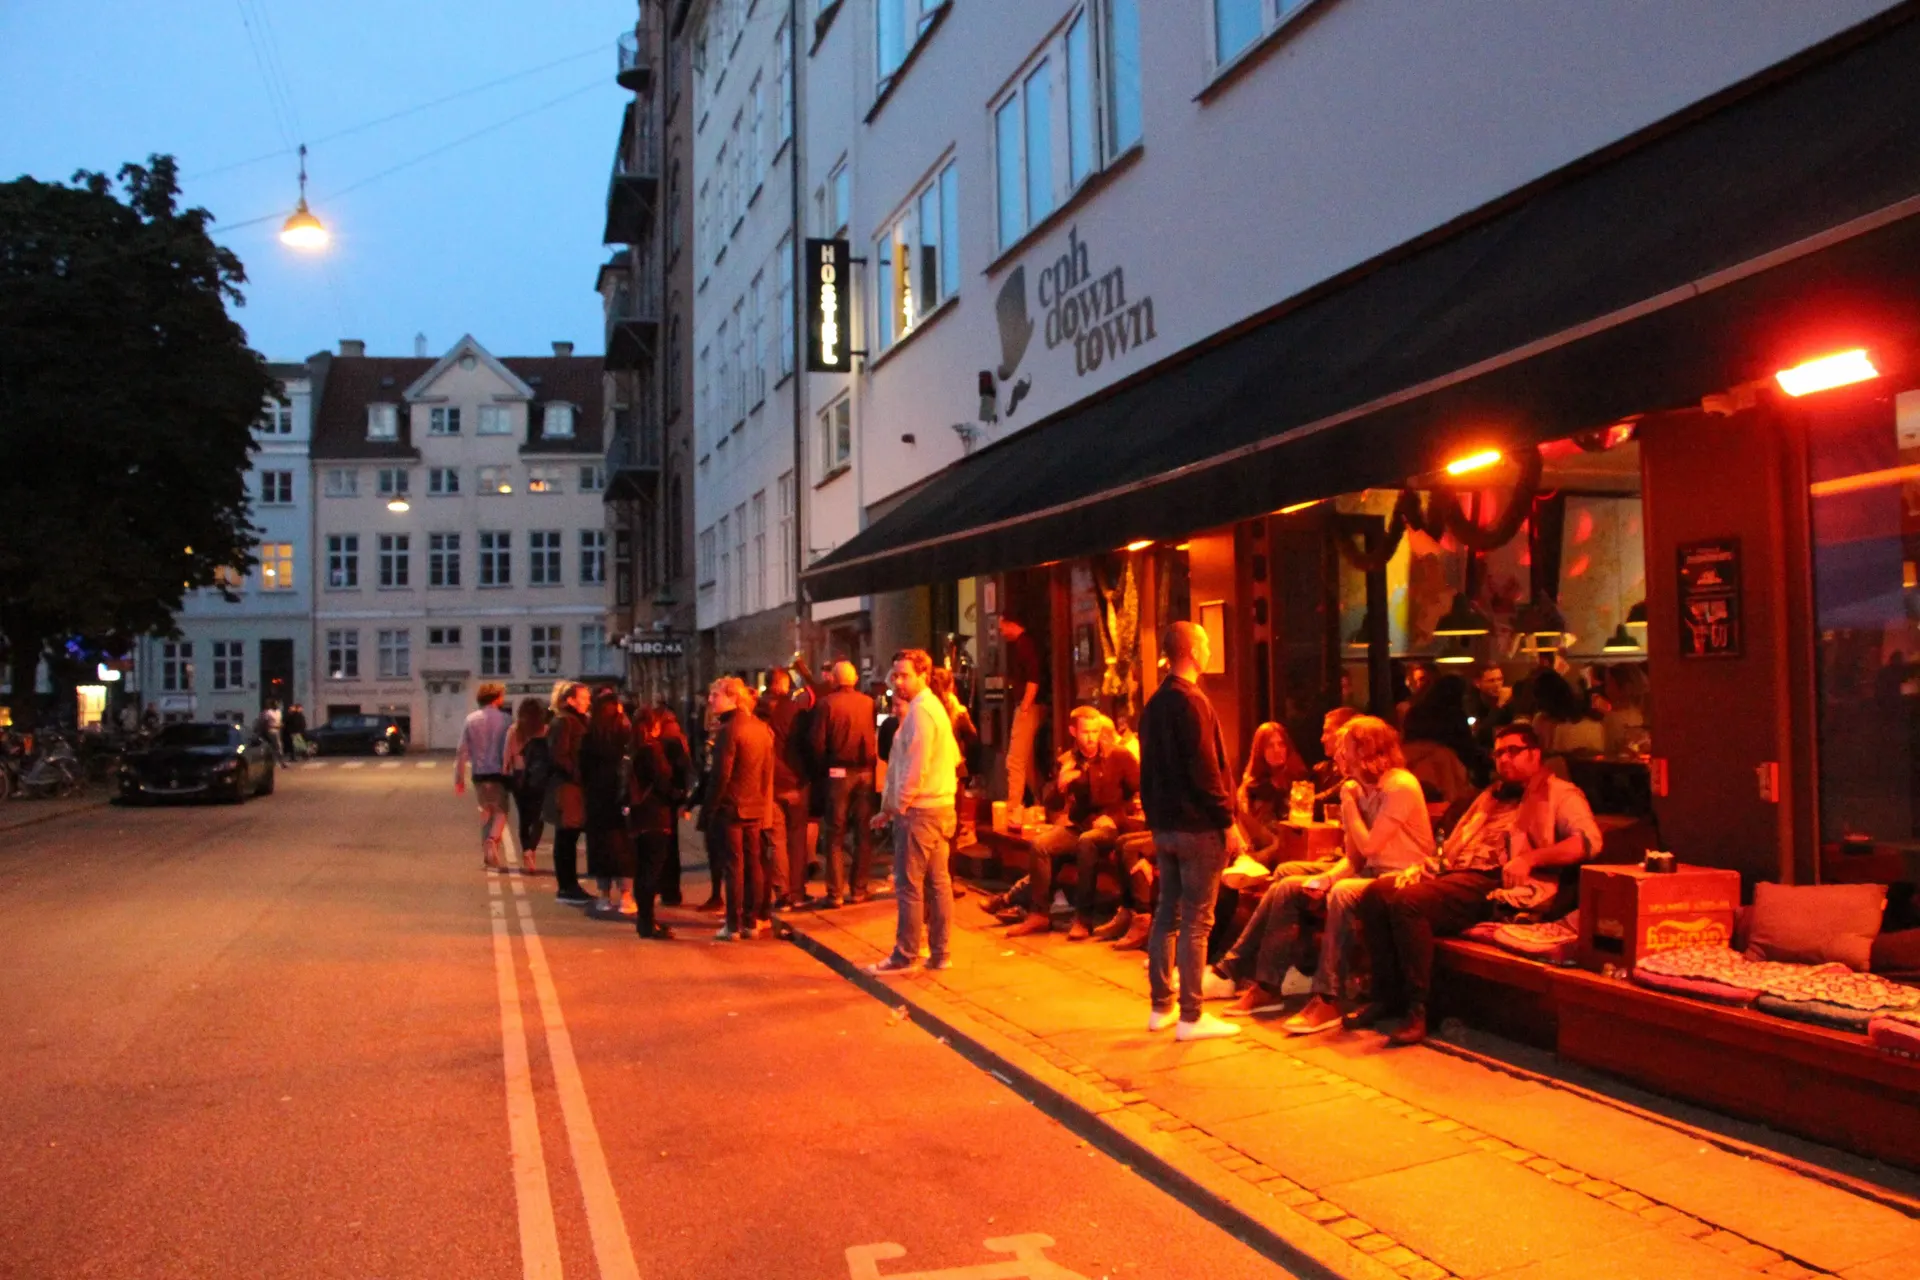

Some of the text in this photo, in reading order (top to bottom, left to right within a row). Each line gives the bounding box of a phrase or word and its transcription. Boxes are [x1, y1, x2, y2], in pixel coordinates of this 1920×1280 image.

[821, 244, 839, 365] HOSTEL
[1038, 227, 1090, 307] cph
[1045, 266, 1125, 349] down
[1074, 296, 1158, 376] town
